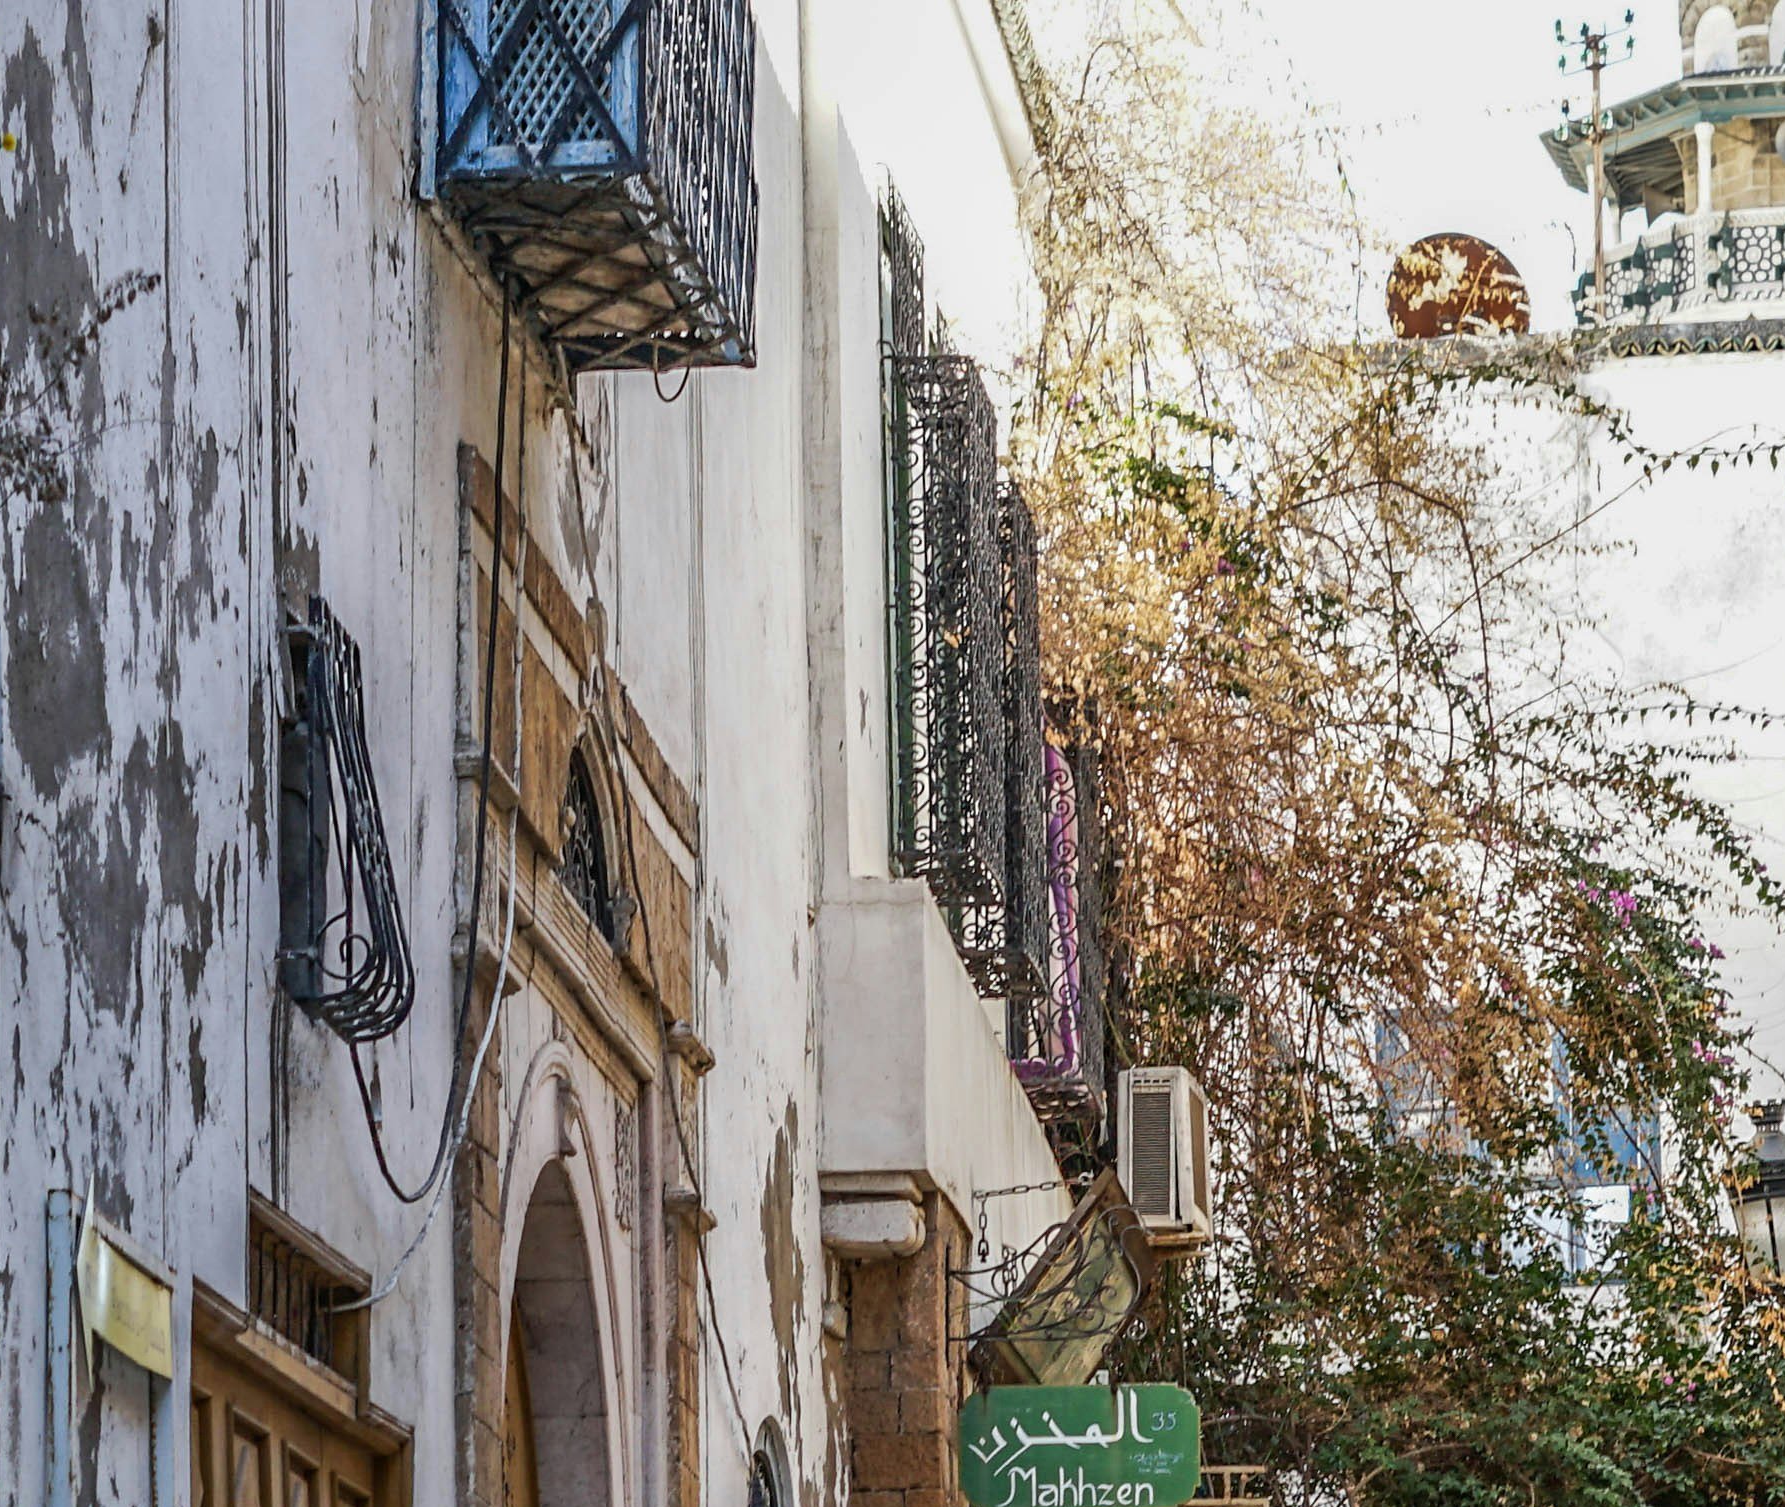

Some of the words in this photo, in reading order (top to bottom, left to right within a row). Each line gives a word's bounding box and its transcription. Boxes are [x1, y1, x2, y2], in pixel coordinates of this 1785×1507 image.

[968, 1387, 1154, 1477] المخزن
[1151, 1411, 1177, 1432] 35
[996, 1466, 1154, 1507] Makhzen
